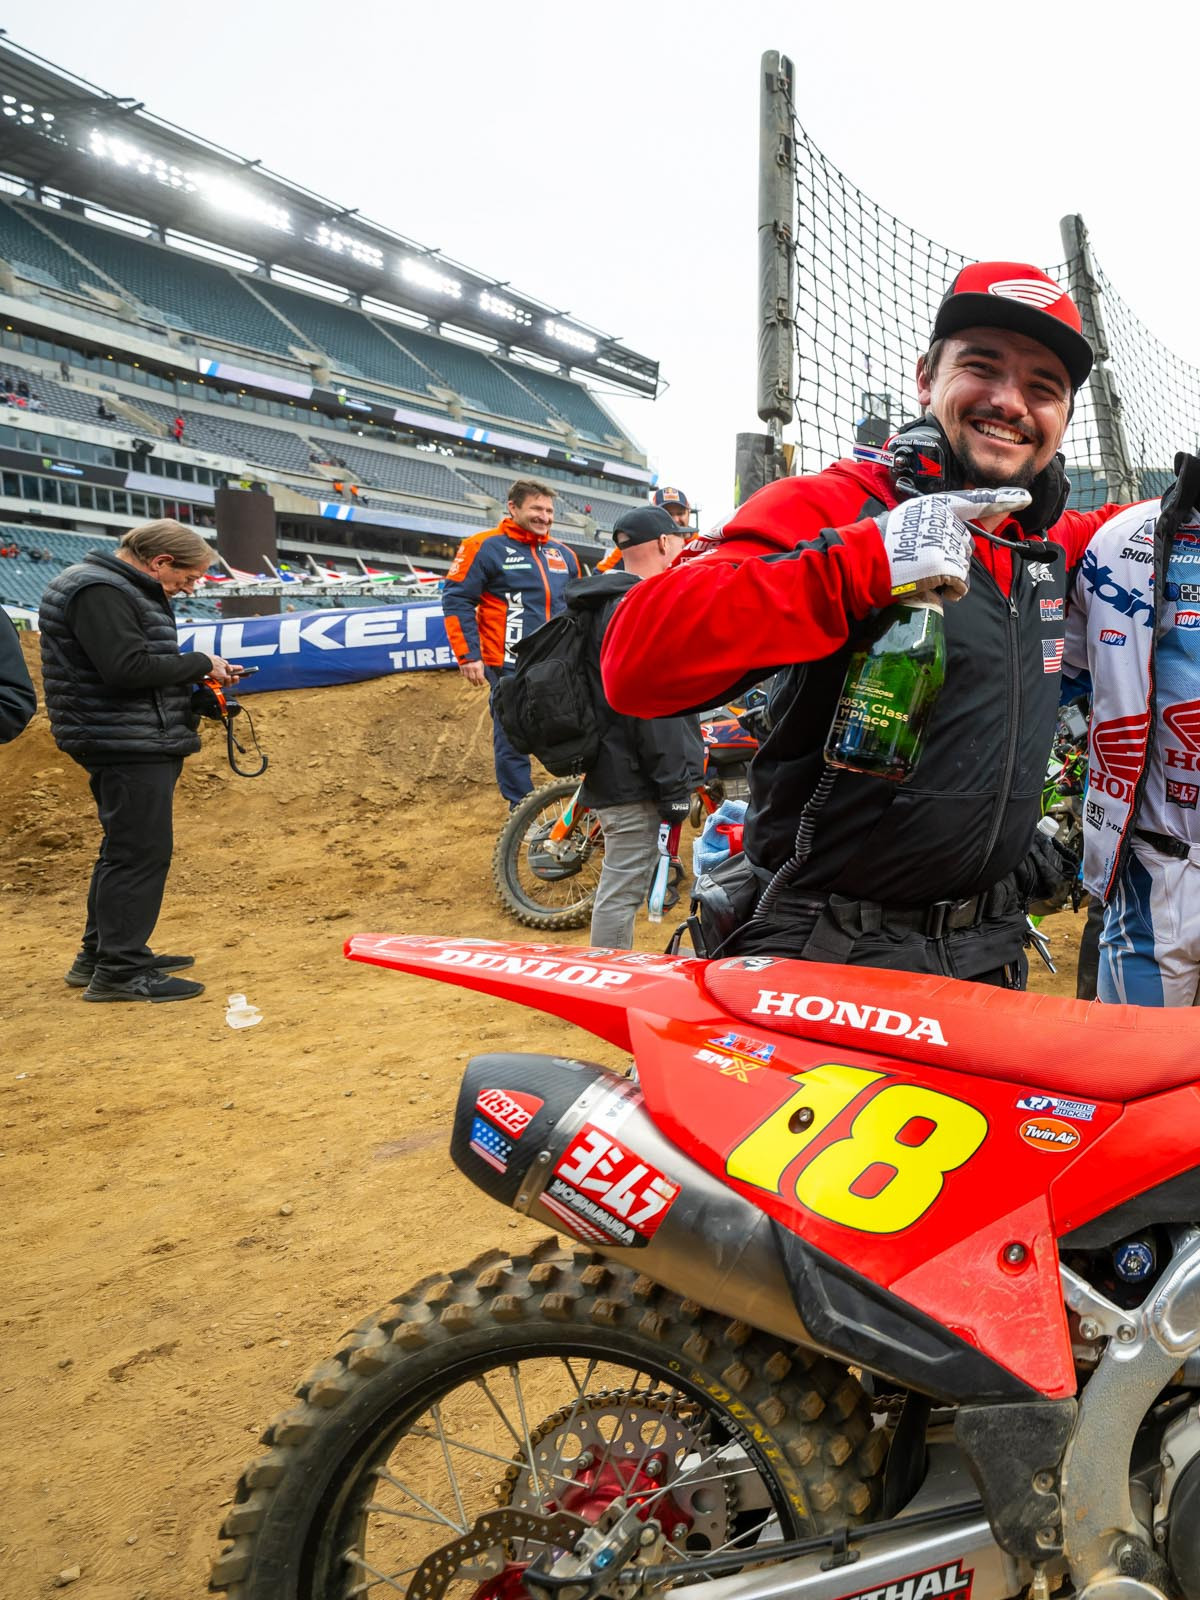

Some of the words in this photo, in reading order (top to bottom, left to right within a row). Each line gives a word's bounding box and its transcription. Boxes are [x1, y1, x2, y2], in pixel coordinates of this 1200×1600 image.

[1101, 631, 1126, 646] 100%
[849, 709, 890, 728] Place
[871, 703, 910, 722] Class
[423, 950, 634, 990] DUNLOP
[751, 989, 949, 1047] HONDA
[708, 1031, 777, 1061] AMA
[697, 1048, 760, 1084] SMX
[725, 1062, 990, 1234] 18
[1025, 1125, 1056, 1140] Twin
[1055, 1131, 1077, 1144] Air
[558, 1130, 682, 1228] ヨシムラ
[550, 1179, 637, 1246] YOSHIMURA
